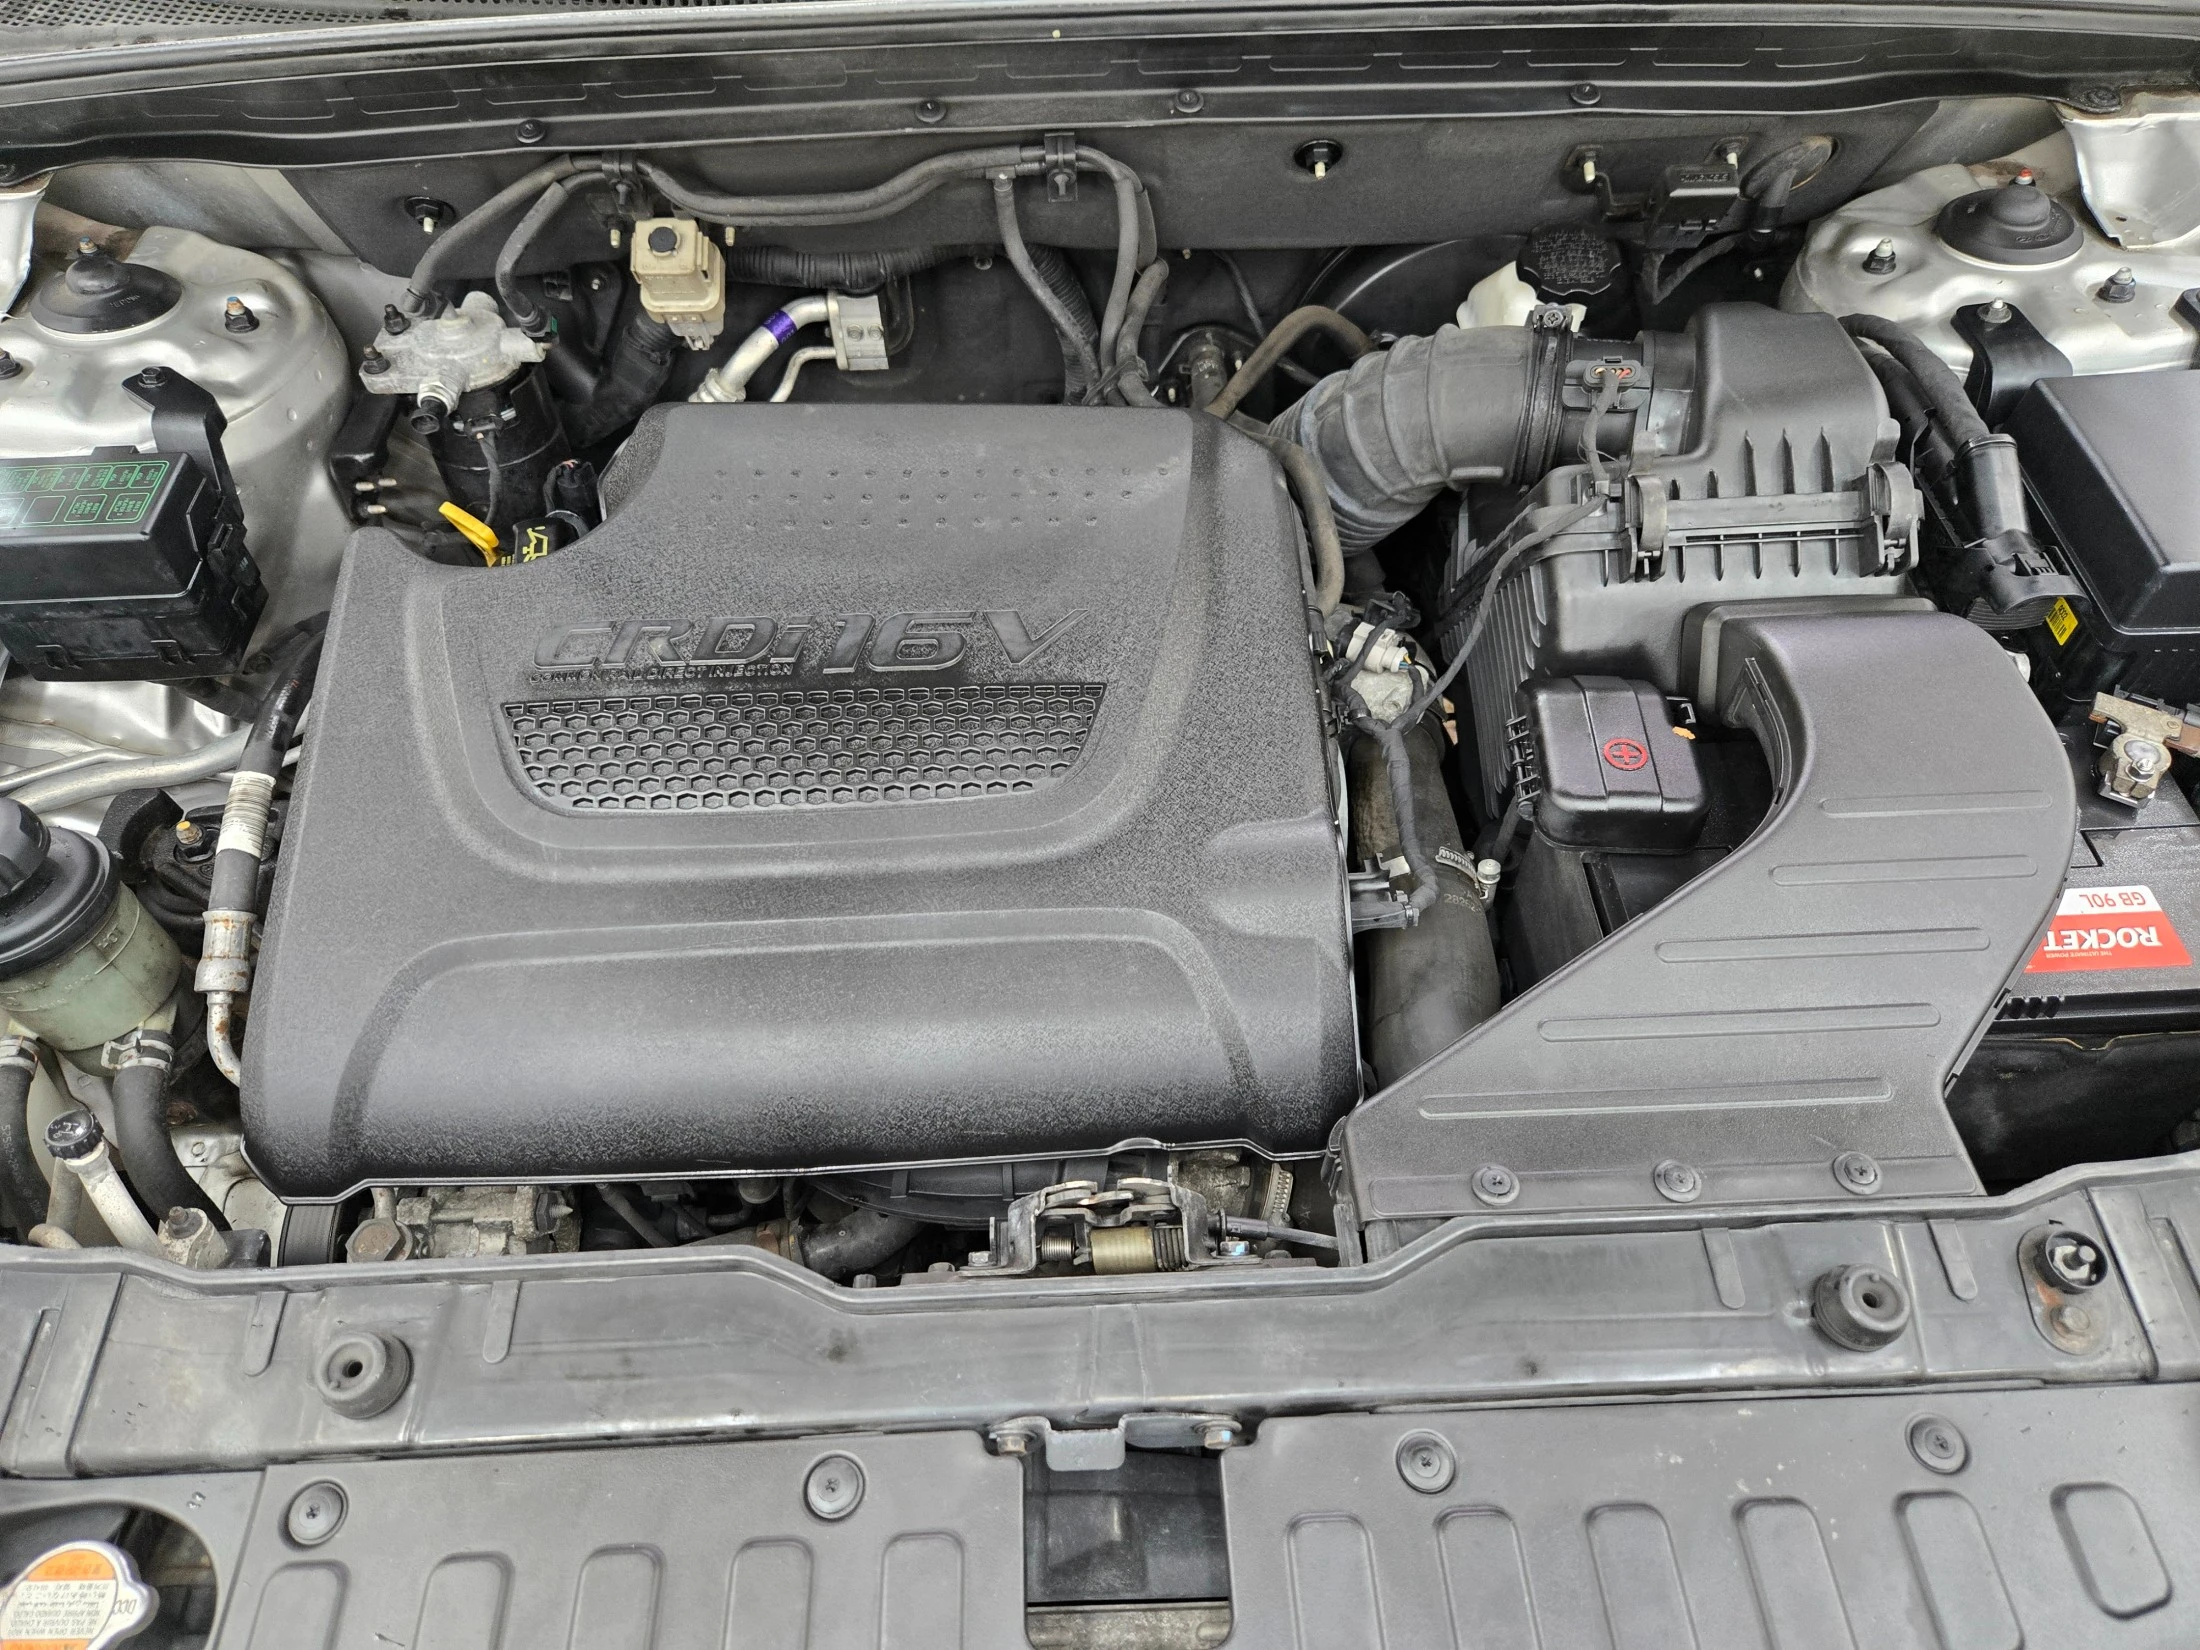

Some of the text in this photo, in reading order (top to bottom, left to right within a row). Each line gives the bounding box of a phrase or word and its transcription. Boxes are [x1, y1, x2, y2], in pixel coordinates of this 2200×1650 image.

[532, 616, 814, 671] CRDi
[529, 663, 795, 685] COMMON RAIL DIRECT INJECTION
[2079, 891, 2146, 908] GB 90L
[2044, 926, 2162, 952] ROCKET
